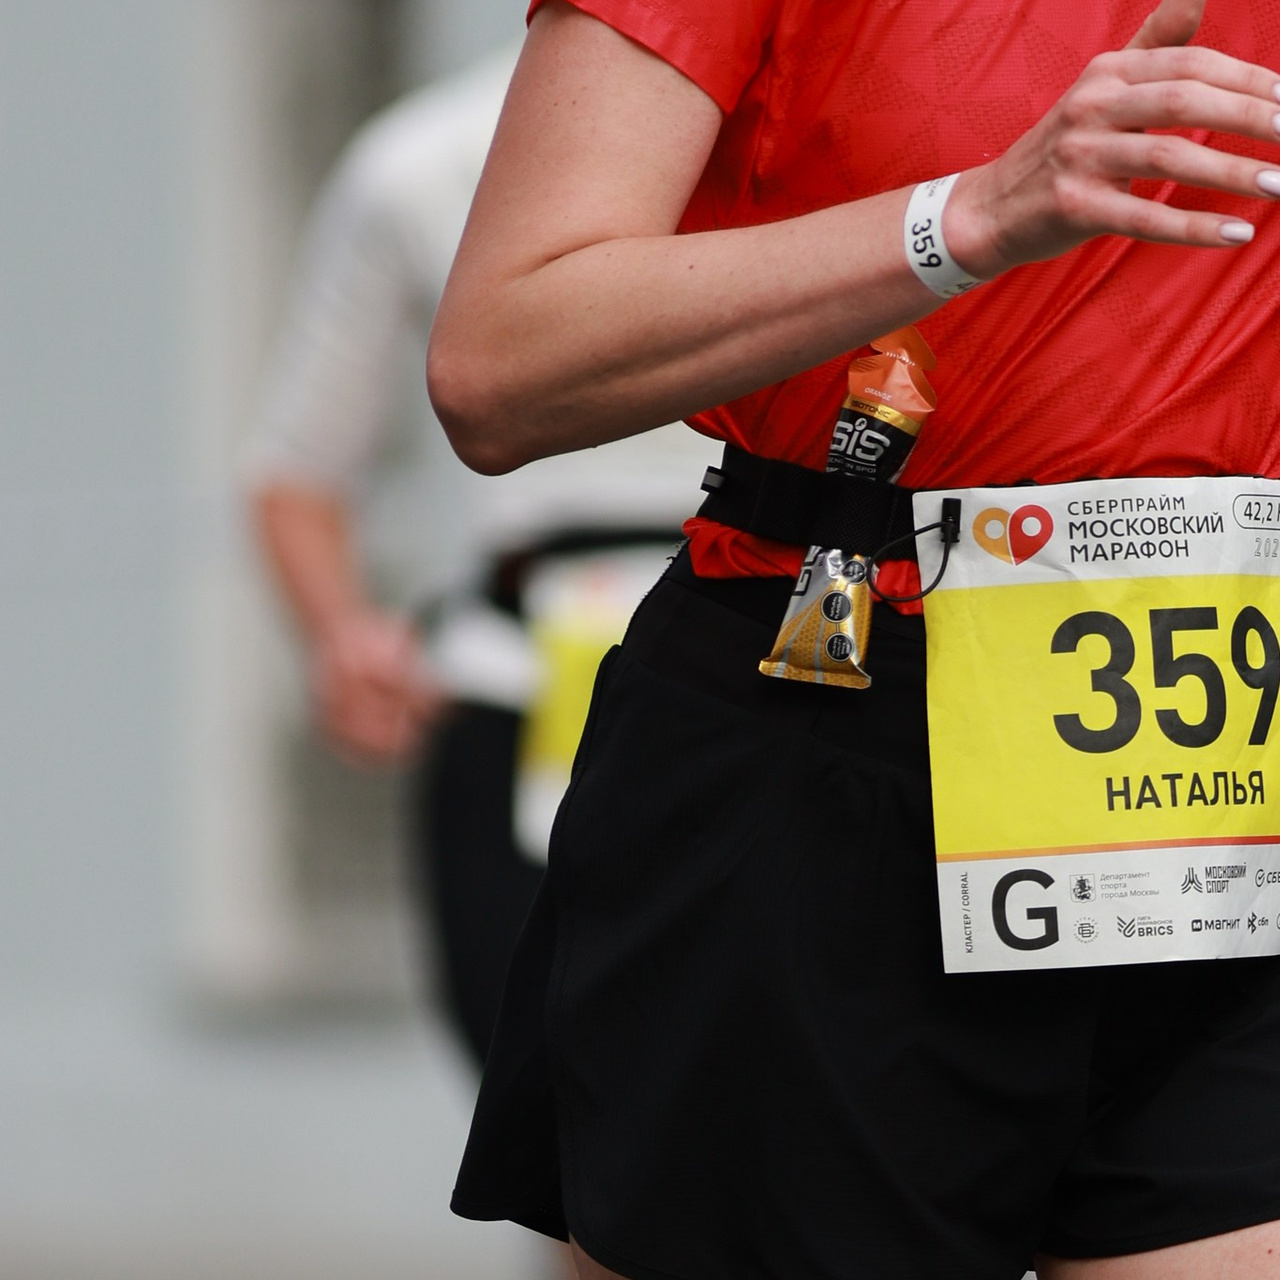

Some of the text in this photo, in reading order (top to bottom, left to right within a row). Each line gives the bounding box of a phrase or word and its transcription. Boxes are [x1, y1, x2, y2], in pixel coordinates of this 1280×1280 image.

[912, 219, 942, 268] 359
[864, 387, 892, 401] ORANGE
[851, 400, 891, 418] ISOTONIC
[1067, 494, 1186, 516] СБЕРПРАЙМ
[1243, 501, 1273, 523] 42,2
[1069, 512, 1225, 540] МОСКОВСКИЙ
[1070, 539, 1190, 563] МАРАФОН
[1105, 770, 1265, 811] НАТАЛЬЯ
[1100, 871, 1150, 881] Департамент
[1100, 883, 1127, 891] спорта
[1205, 879, 1230, 894] СПОРТ
[960, 871, 970, 907] CORRAL
[1101, 889, 1160, 900] города Москвы
[991, 868, 1059, 951] G
[962, 914, 974, 954] КЛАСТЕР
[1137, 925, 1174, 938] BRICS
